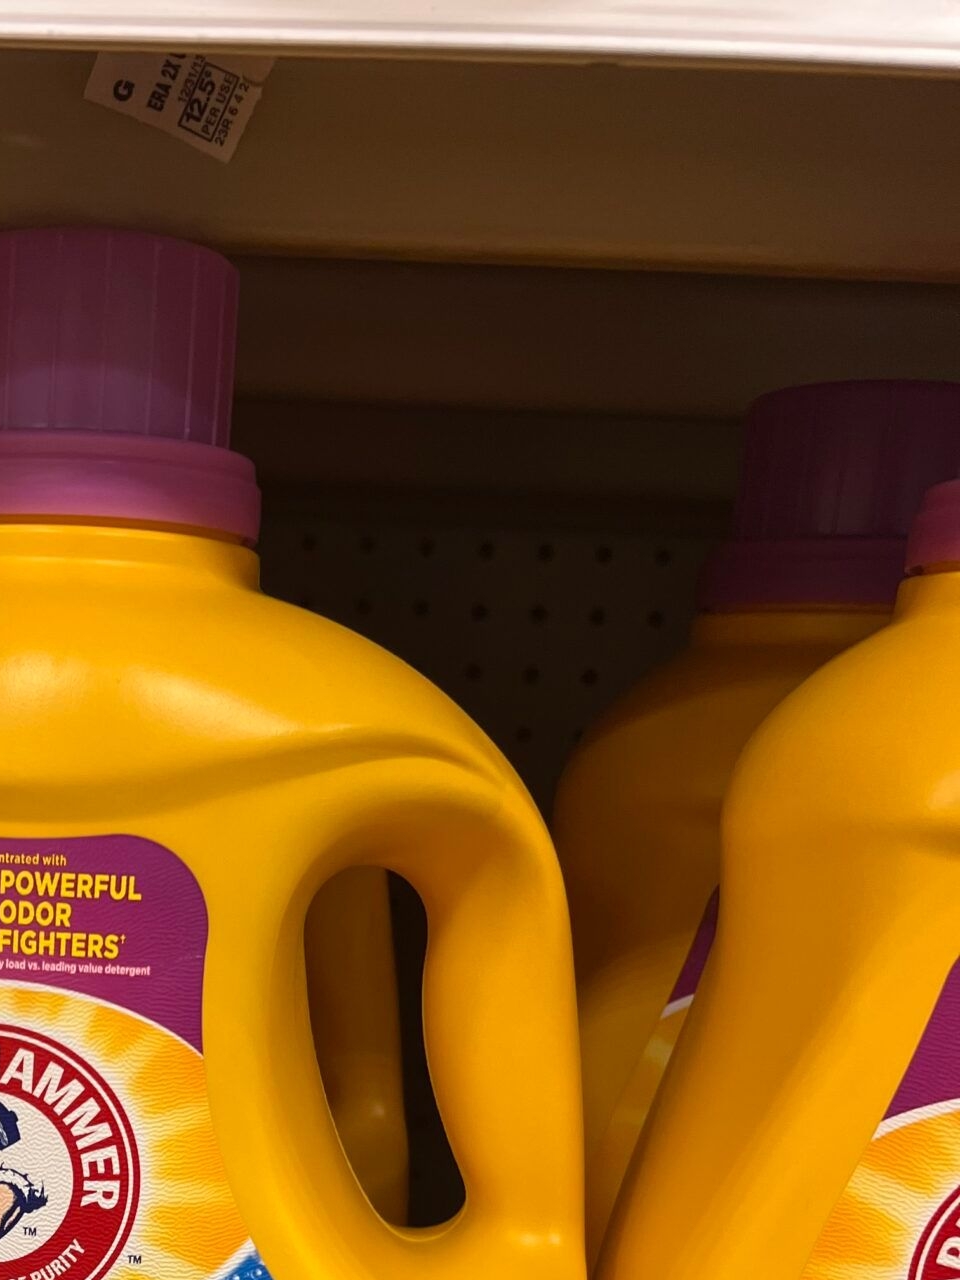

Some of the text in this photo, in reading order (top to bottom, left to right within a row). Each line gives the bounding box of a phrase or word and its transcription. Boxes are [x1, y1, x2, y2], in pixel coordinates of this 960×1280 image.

[113, 80, 135, 102] G
[146, 84, 172, 112] ERA
[161, 60, 181, 82] 2X
[202, 74, 239, 135] PER USE
[42, 853, 67, 867] with
[0, 870, 142, 901] POWERFUL
[6, 958, 26, 970] load
[28, 962, 41, 971] vs.
[42, 960, 77, 974] leading
[78, 962, 103, 974] value
[104, 964, 151, 977] detergent
